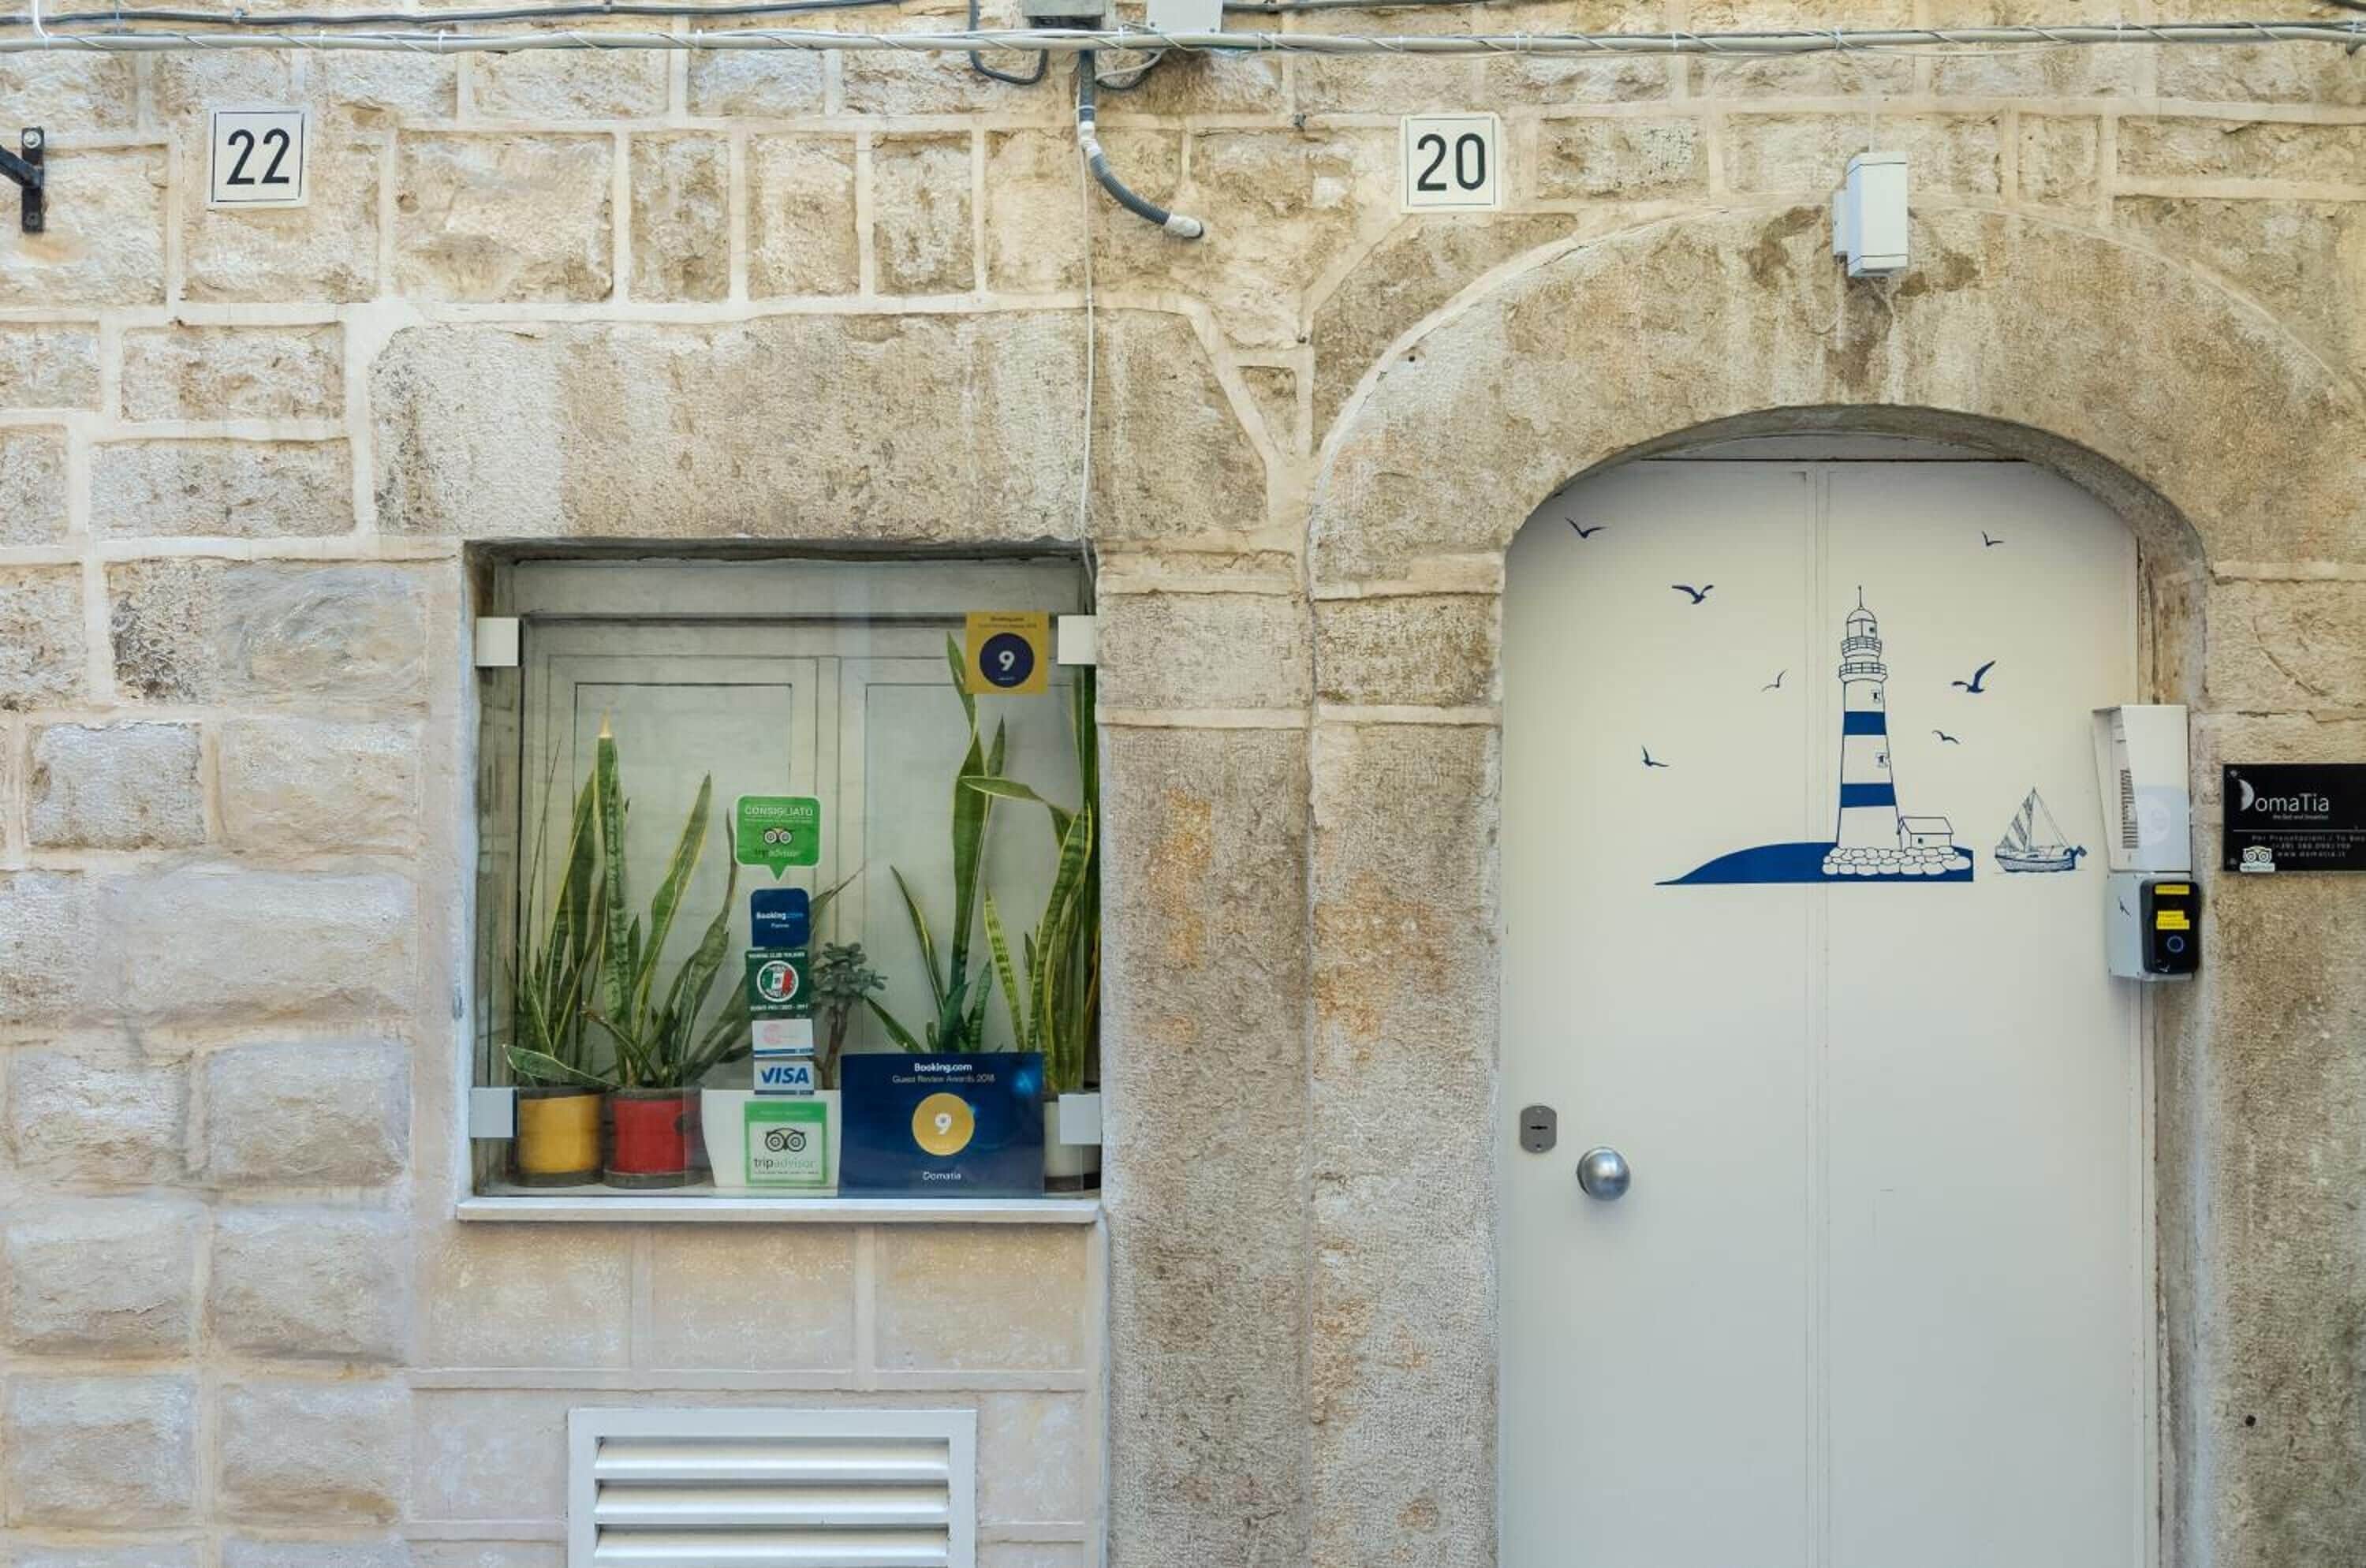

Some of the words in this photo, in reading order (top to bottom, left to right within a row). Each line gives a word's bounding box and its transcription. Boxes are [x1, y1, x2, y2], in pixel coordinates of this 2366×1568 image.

[227, 128, 290, 185] 22
[1417, 133, 1485, 191] 20
[998, 650, 1015, 671] 9
[745, 806, 813, 816] CONSIGLIATO
[761, 1067, 809, 1084] VISA
[914, 1062, 972, 1073] Booking.com
[935, 1113, 952, 1135] 9
[754, 1156, 815, 1170] tripadvisor
[922, 1170, 961, 1181] Domatia
